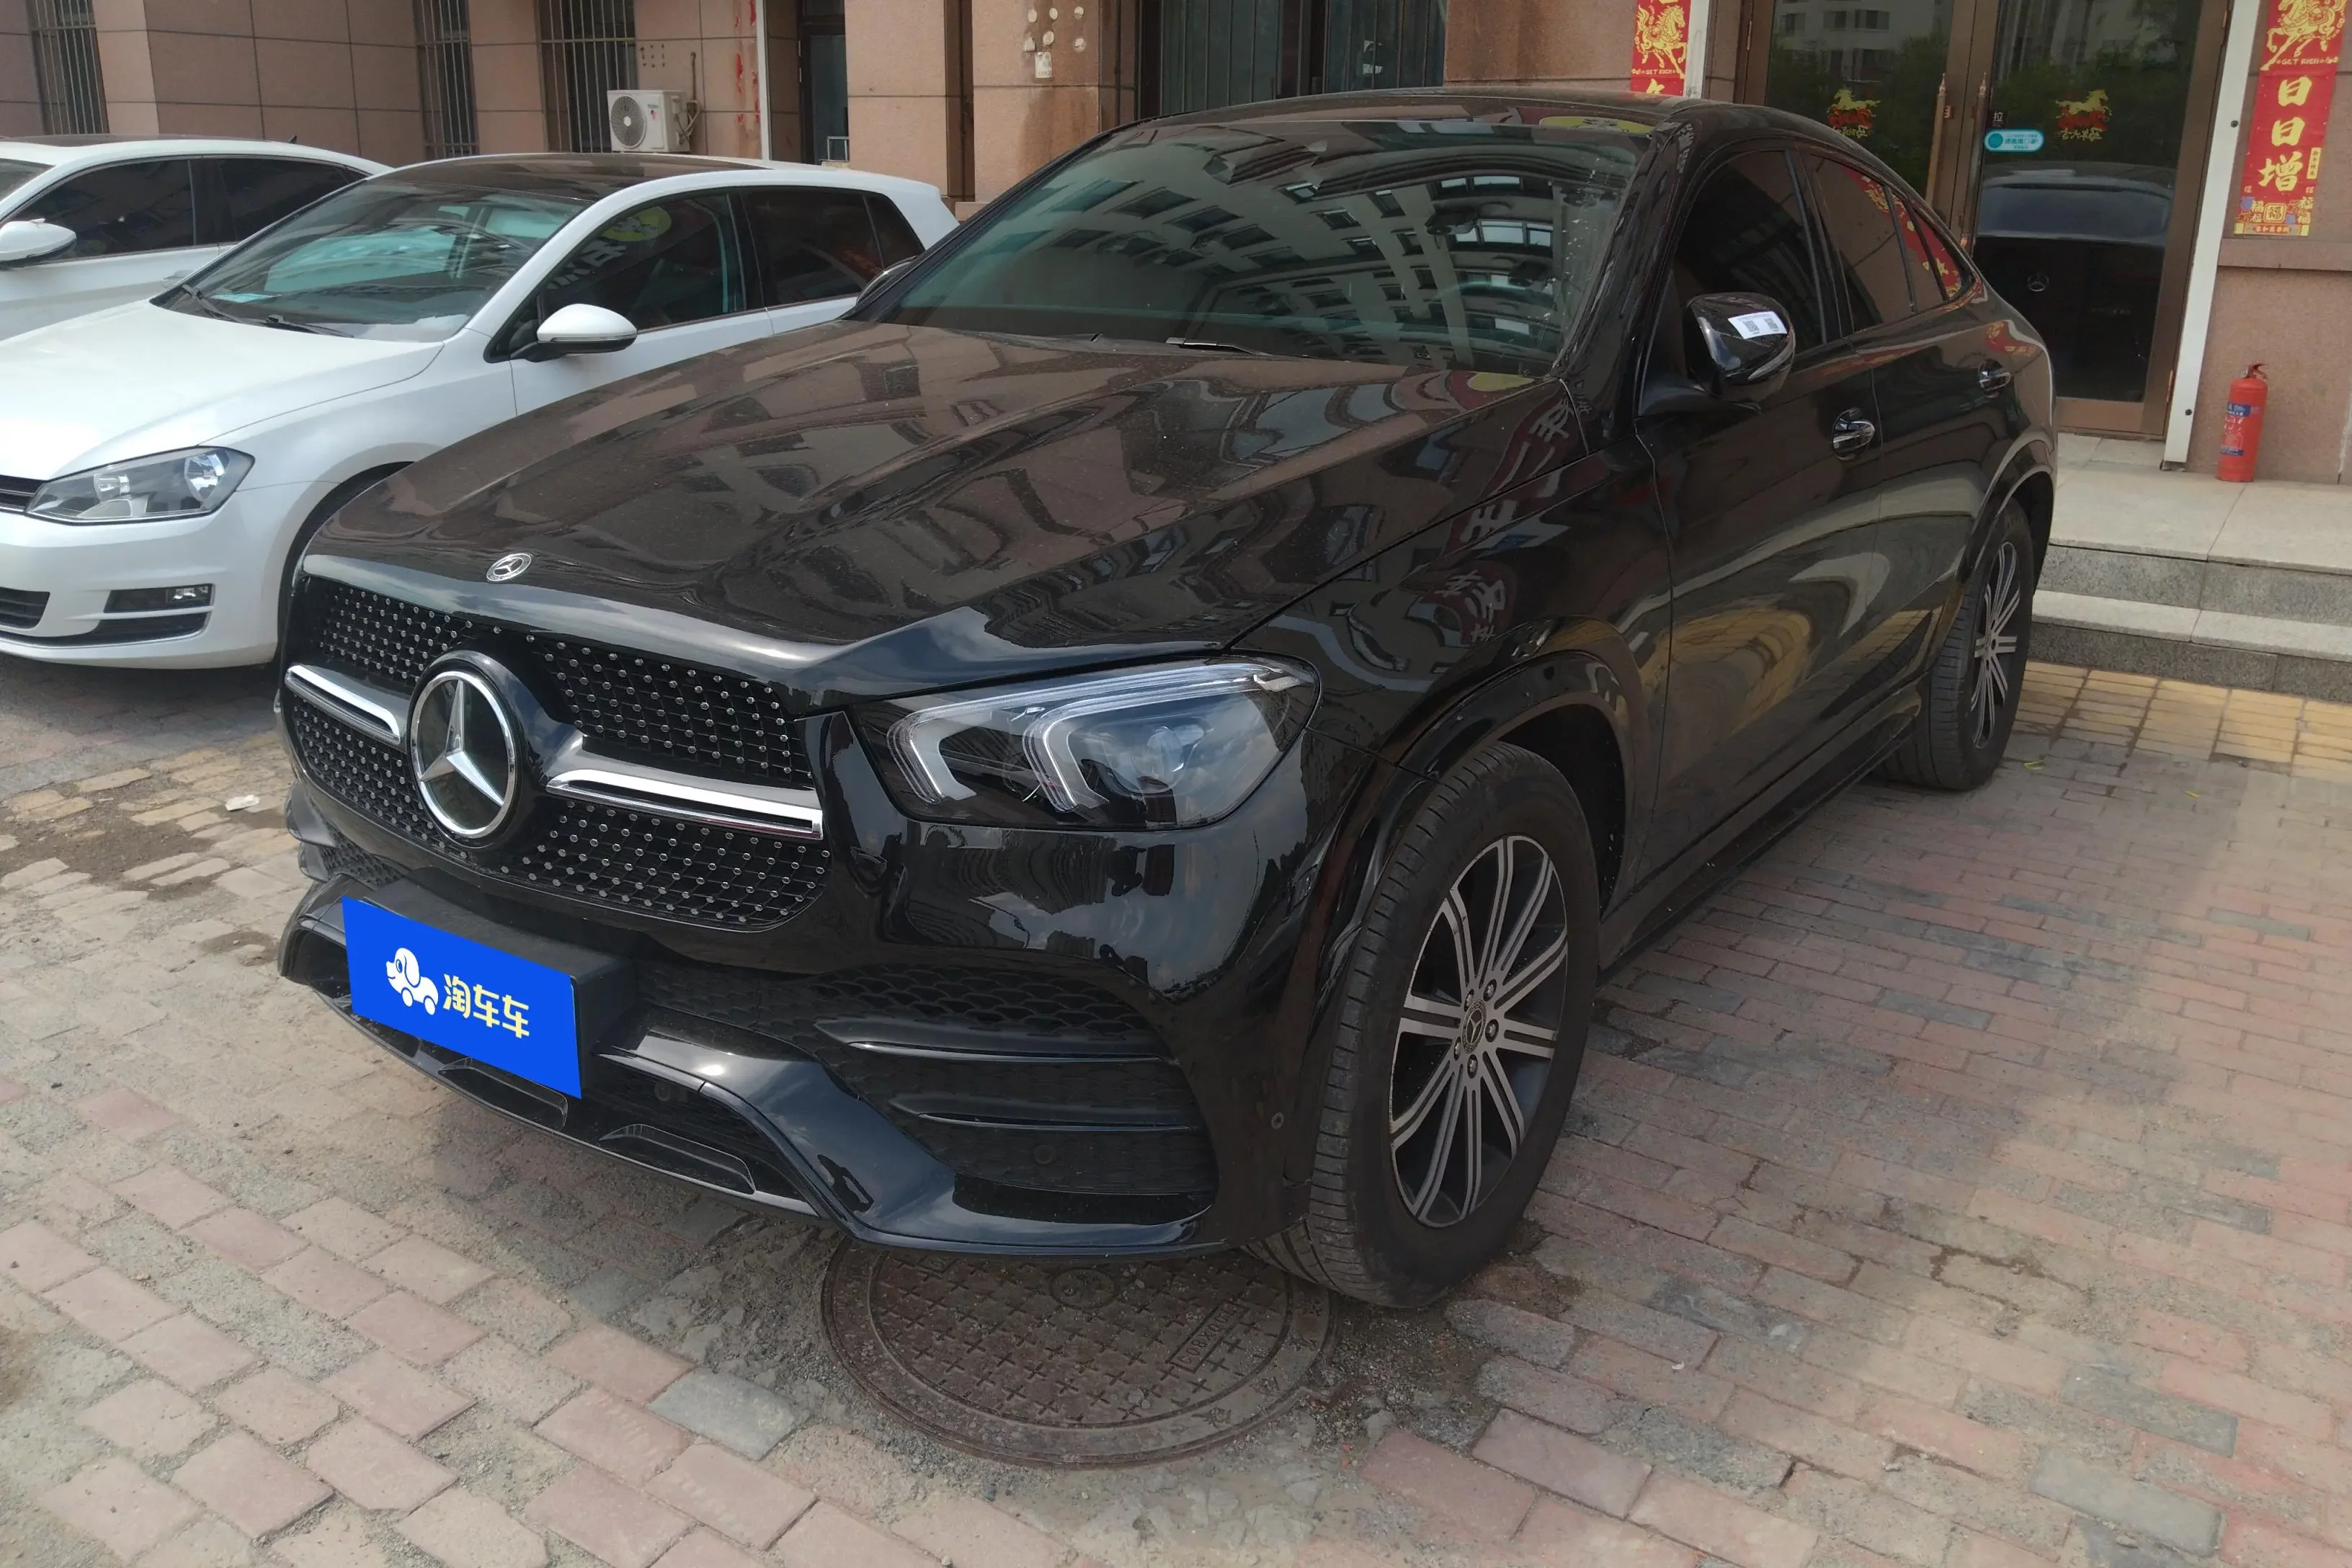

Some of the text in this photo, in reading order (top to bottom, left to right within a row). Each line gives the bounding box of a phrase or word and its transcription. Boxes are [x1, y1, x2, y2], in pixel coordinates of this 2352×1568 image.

[1993, 111, 2004, 122] 拉
[2258, 76, 2312, 192] 日日增
